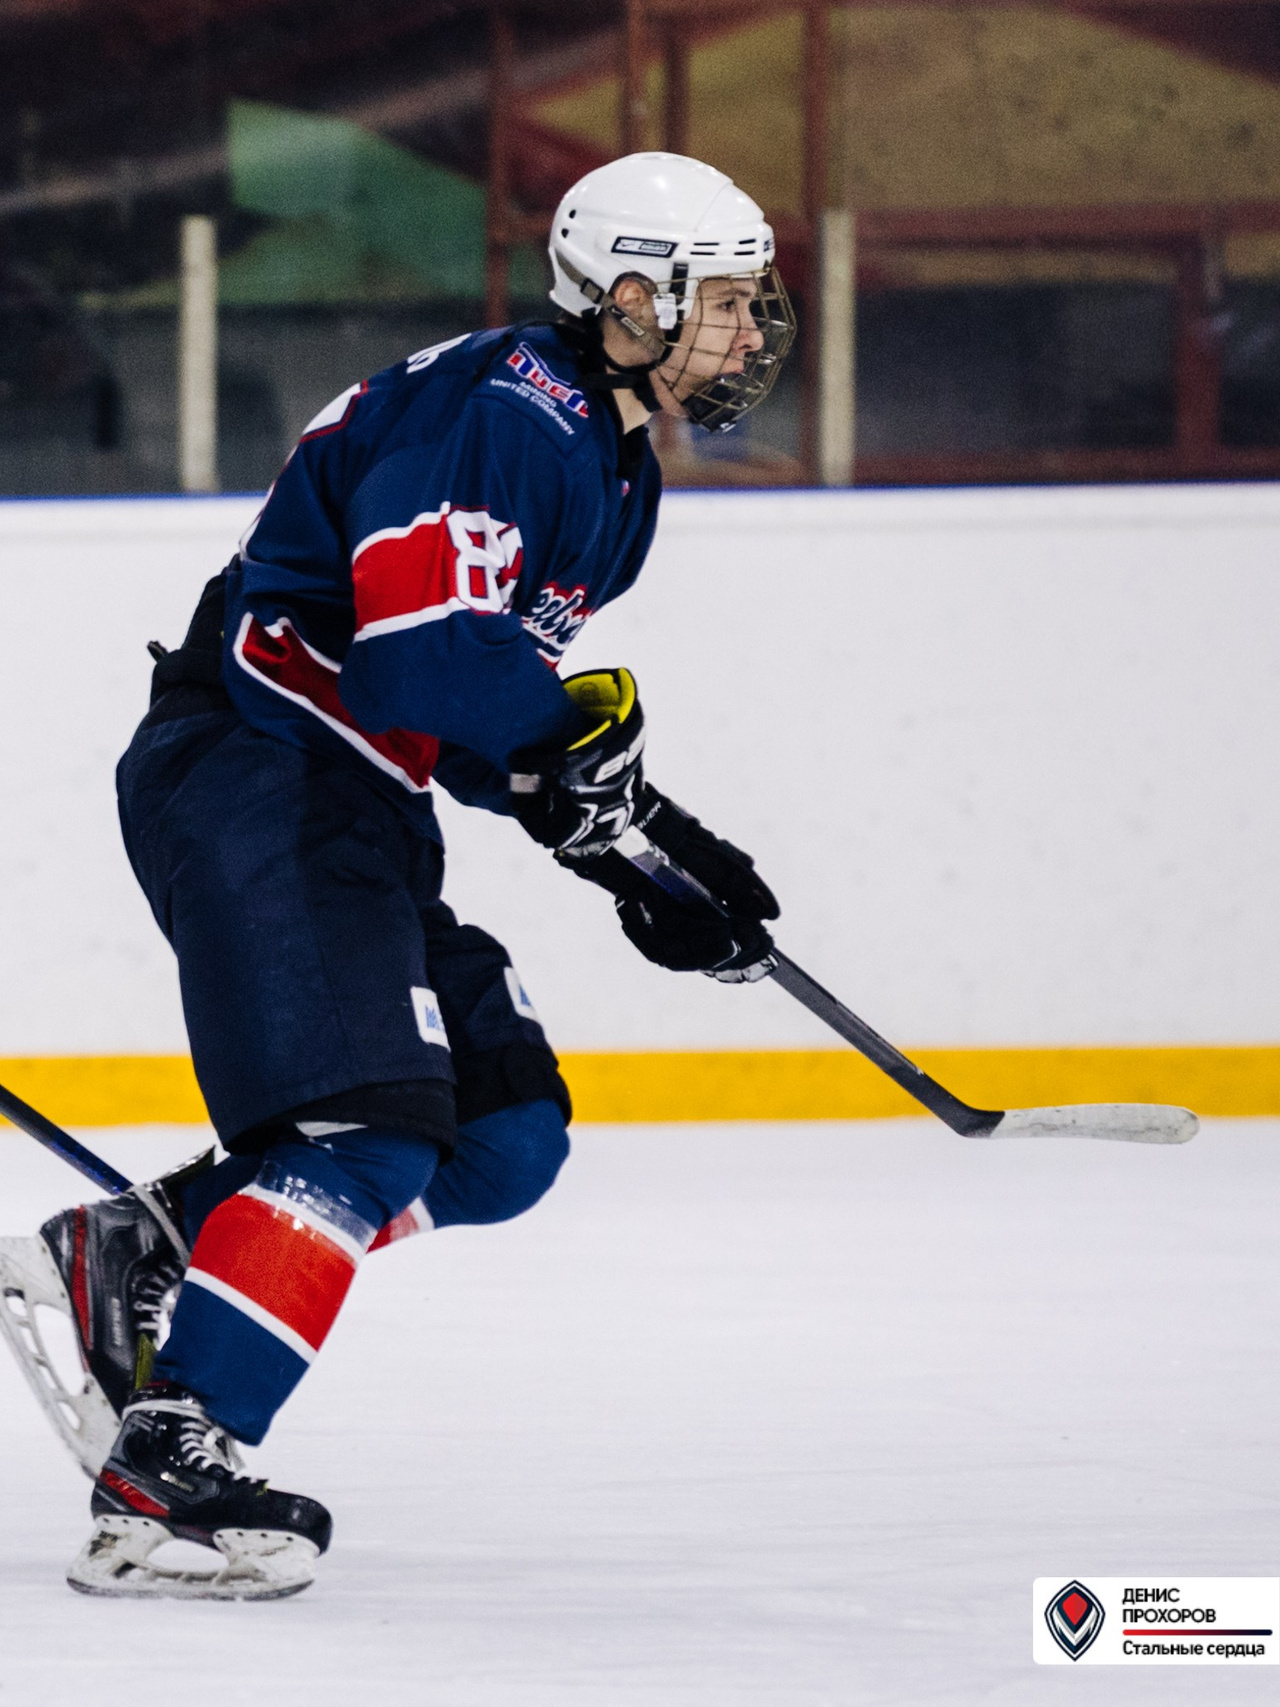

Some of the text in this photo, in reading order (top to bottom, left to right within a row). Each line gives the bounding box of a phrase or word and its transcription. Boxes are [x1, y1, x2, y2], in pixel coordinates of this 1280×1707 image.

[490, 378, 531, 398] UNITED
[530, 395, 575, 435] COMPANY
[519, 381, 557, 408] MINING
